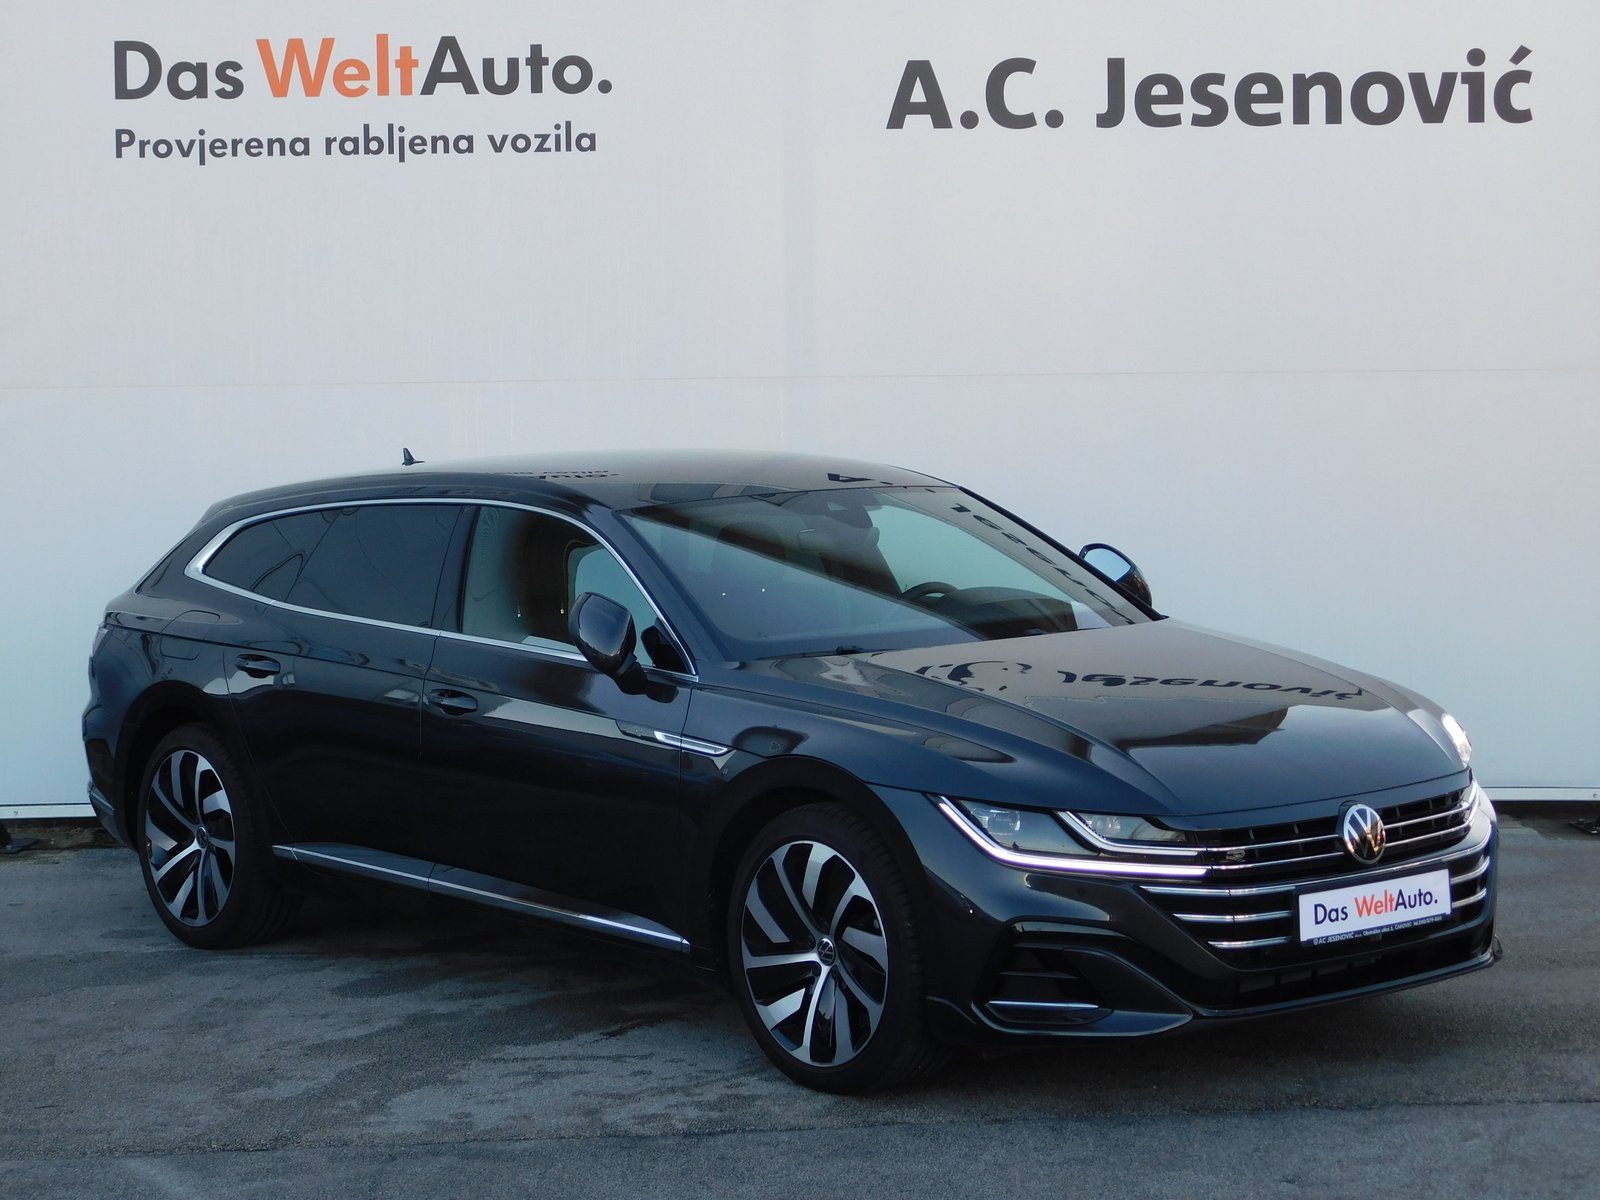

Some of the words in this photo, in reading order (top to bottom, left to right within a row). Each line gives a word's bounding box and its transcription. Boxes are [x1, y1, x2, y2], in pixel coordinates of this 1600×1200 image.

[113, 40, 244, 101] Das
[256, 33, 613, 99] WeltAuto.
[886, 57, 1065, 130] A.C.
[1096, 44, 1534, 129] Jesenović
[115, 128, 310, 167] Provjerena
[325, 123, 474, 164] rabljena
[487, 121, 597, 154] vozila
[1314, 902, 1349, 925] Das
[1354, 888, 1438, 919] WeltAuto.
